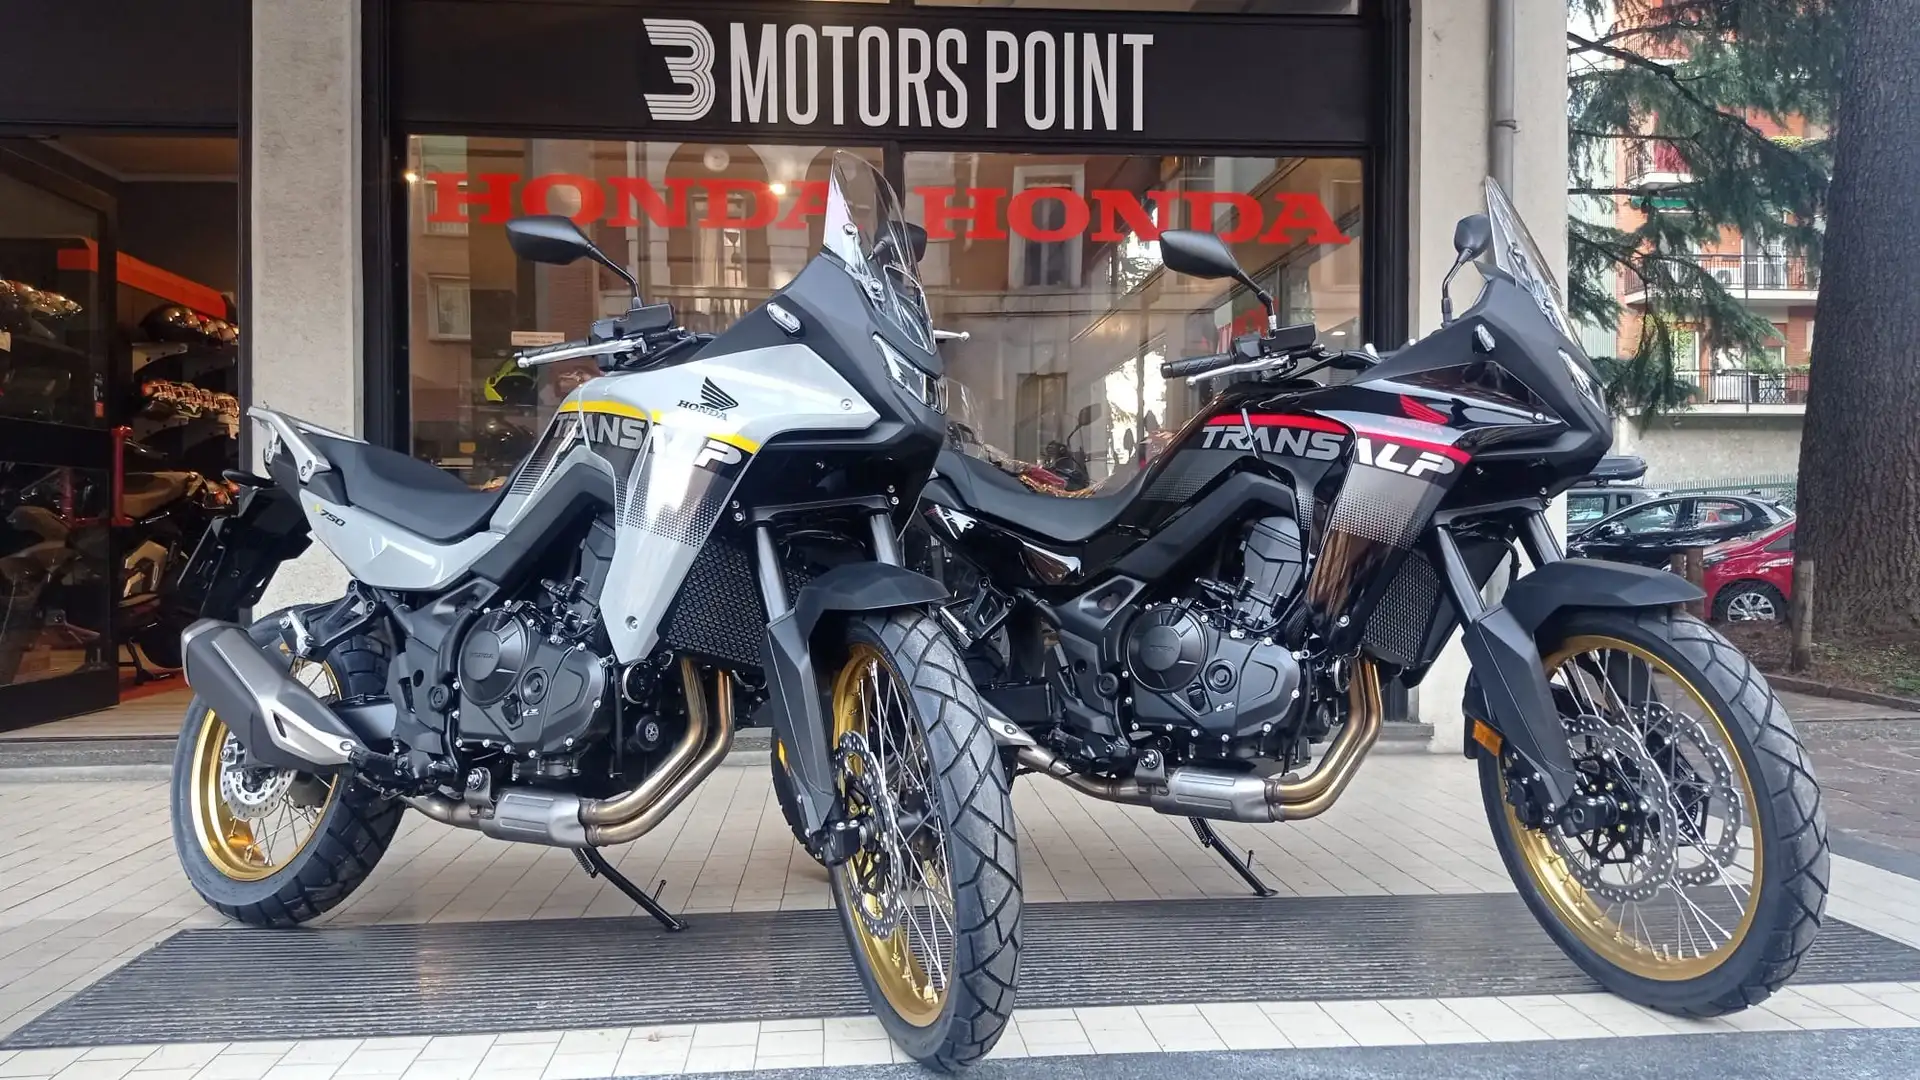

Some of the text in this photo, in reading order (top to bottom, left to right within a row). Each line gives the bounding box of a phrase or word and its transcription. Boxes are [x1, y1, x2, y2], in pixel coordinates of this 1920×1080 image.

[643, 18, 1154, 131] 3 MOTORS POINT
[914, 186, 1351, 245] HONDA
[676, 399, 728, 421] HONDA
[1201, 425, 1455, 477] TRANS ALP
